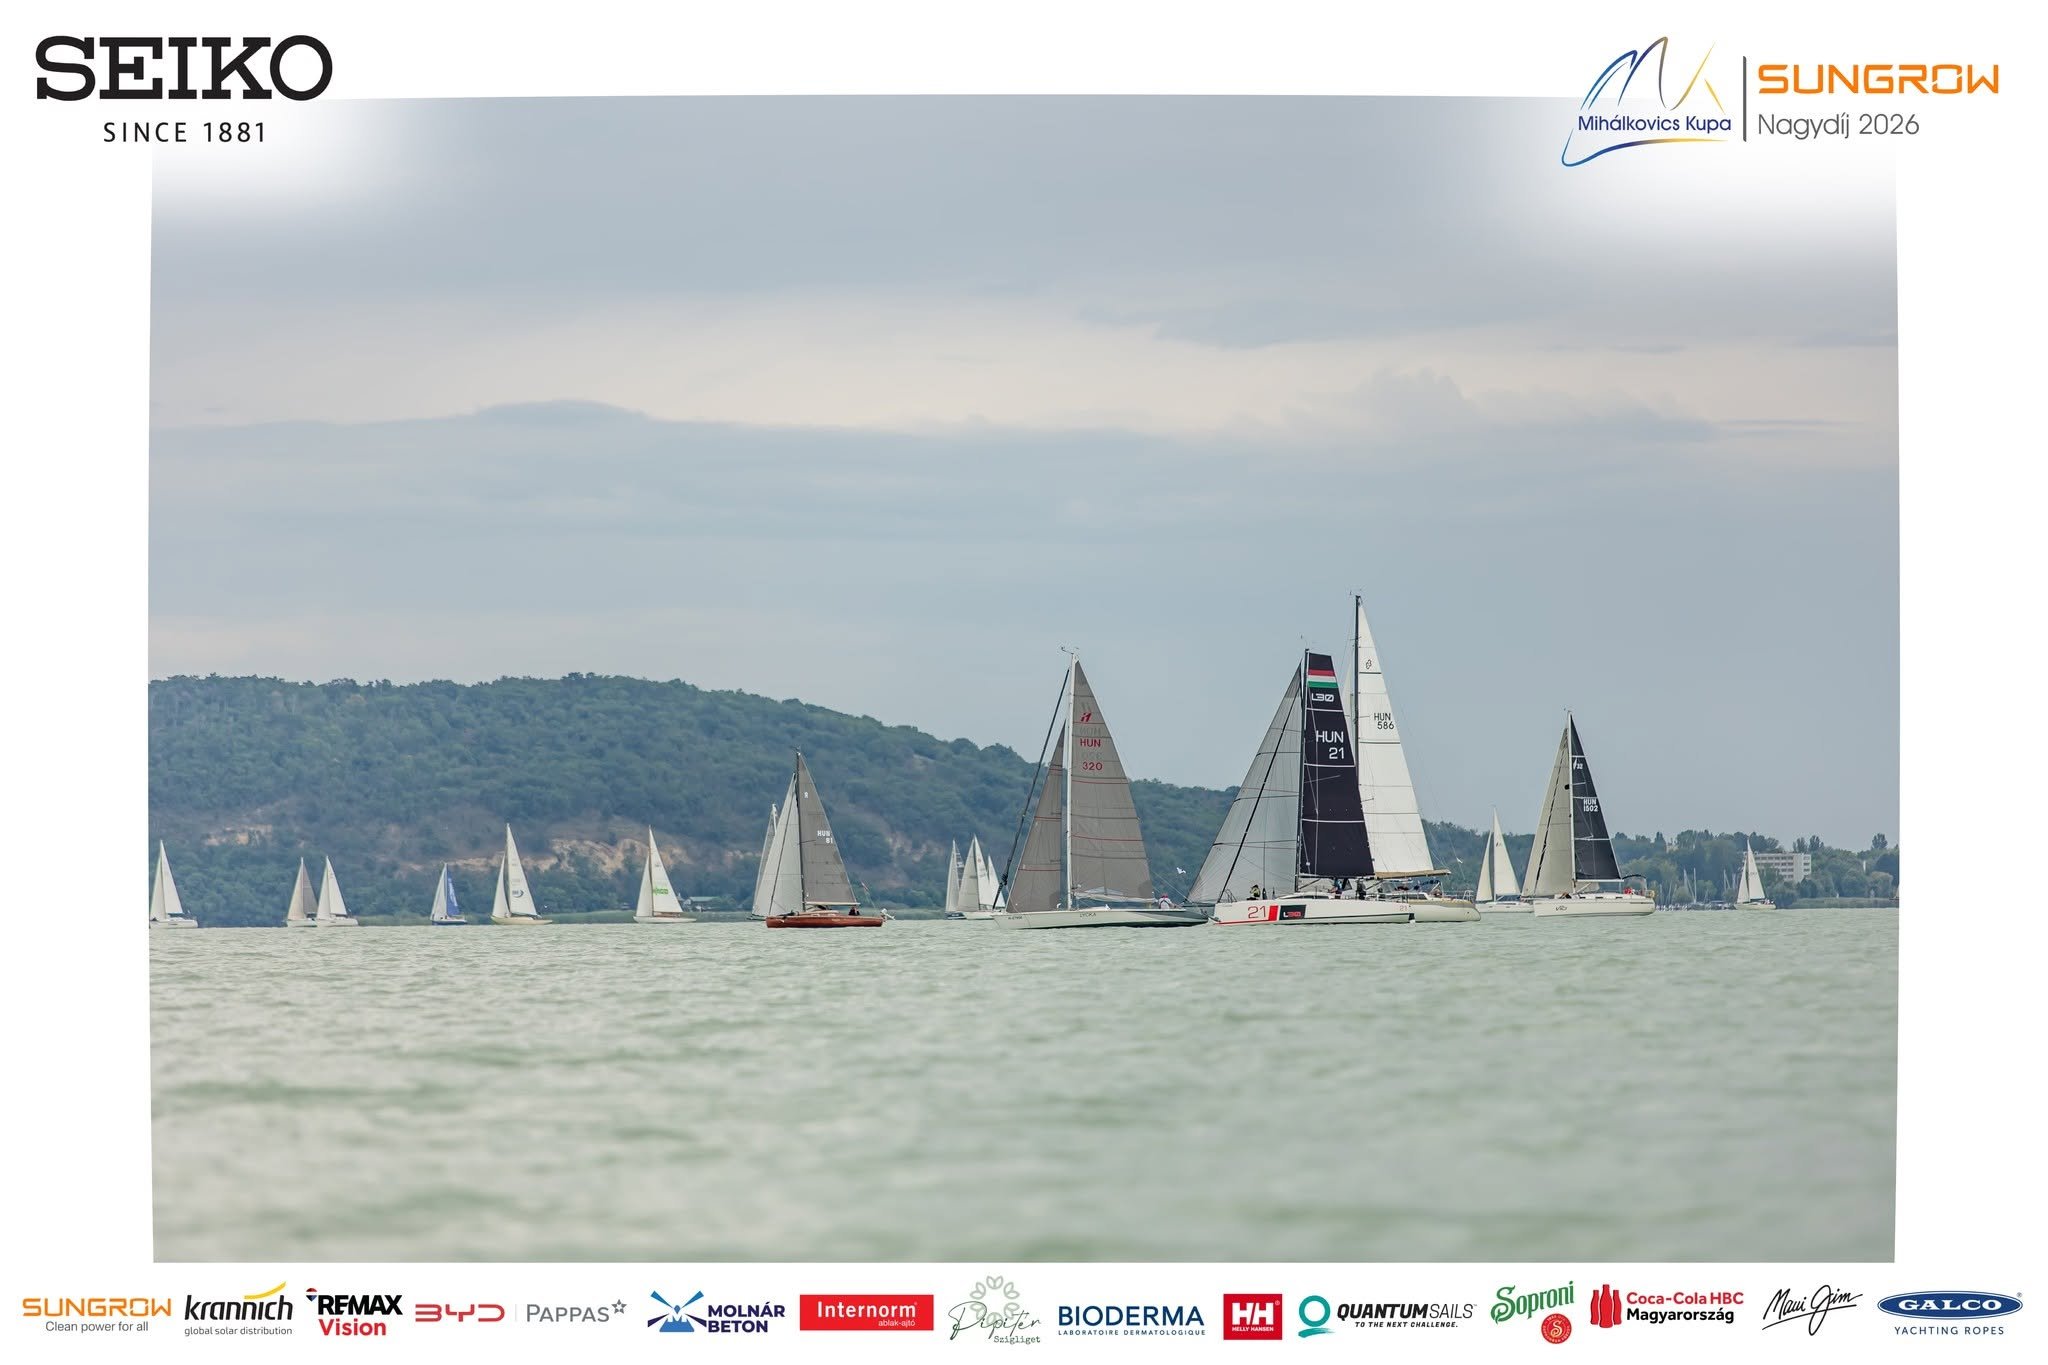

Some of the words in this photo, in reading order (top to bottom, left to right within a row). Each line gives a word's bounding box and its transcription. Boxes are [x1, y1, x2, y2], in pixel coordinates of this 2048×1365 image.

[1373, 713, 1391, 721] HUN
[1377, 721, 1395, 730] 586
[1316, 730, 1344, 743] HUN
[1080, 738, 1101, 748] HUN
[1328, 747, 1345, 759] 21
[1082, 761, 1103, 771] 320
[1247, 905, 1266, 919] 21
